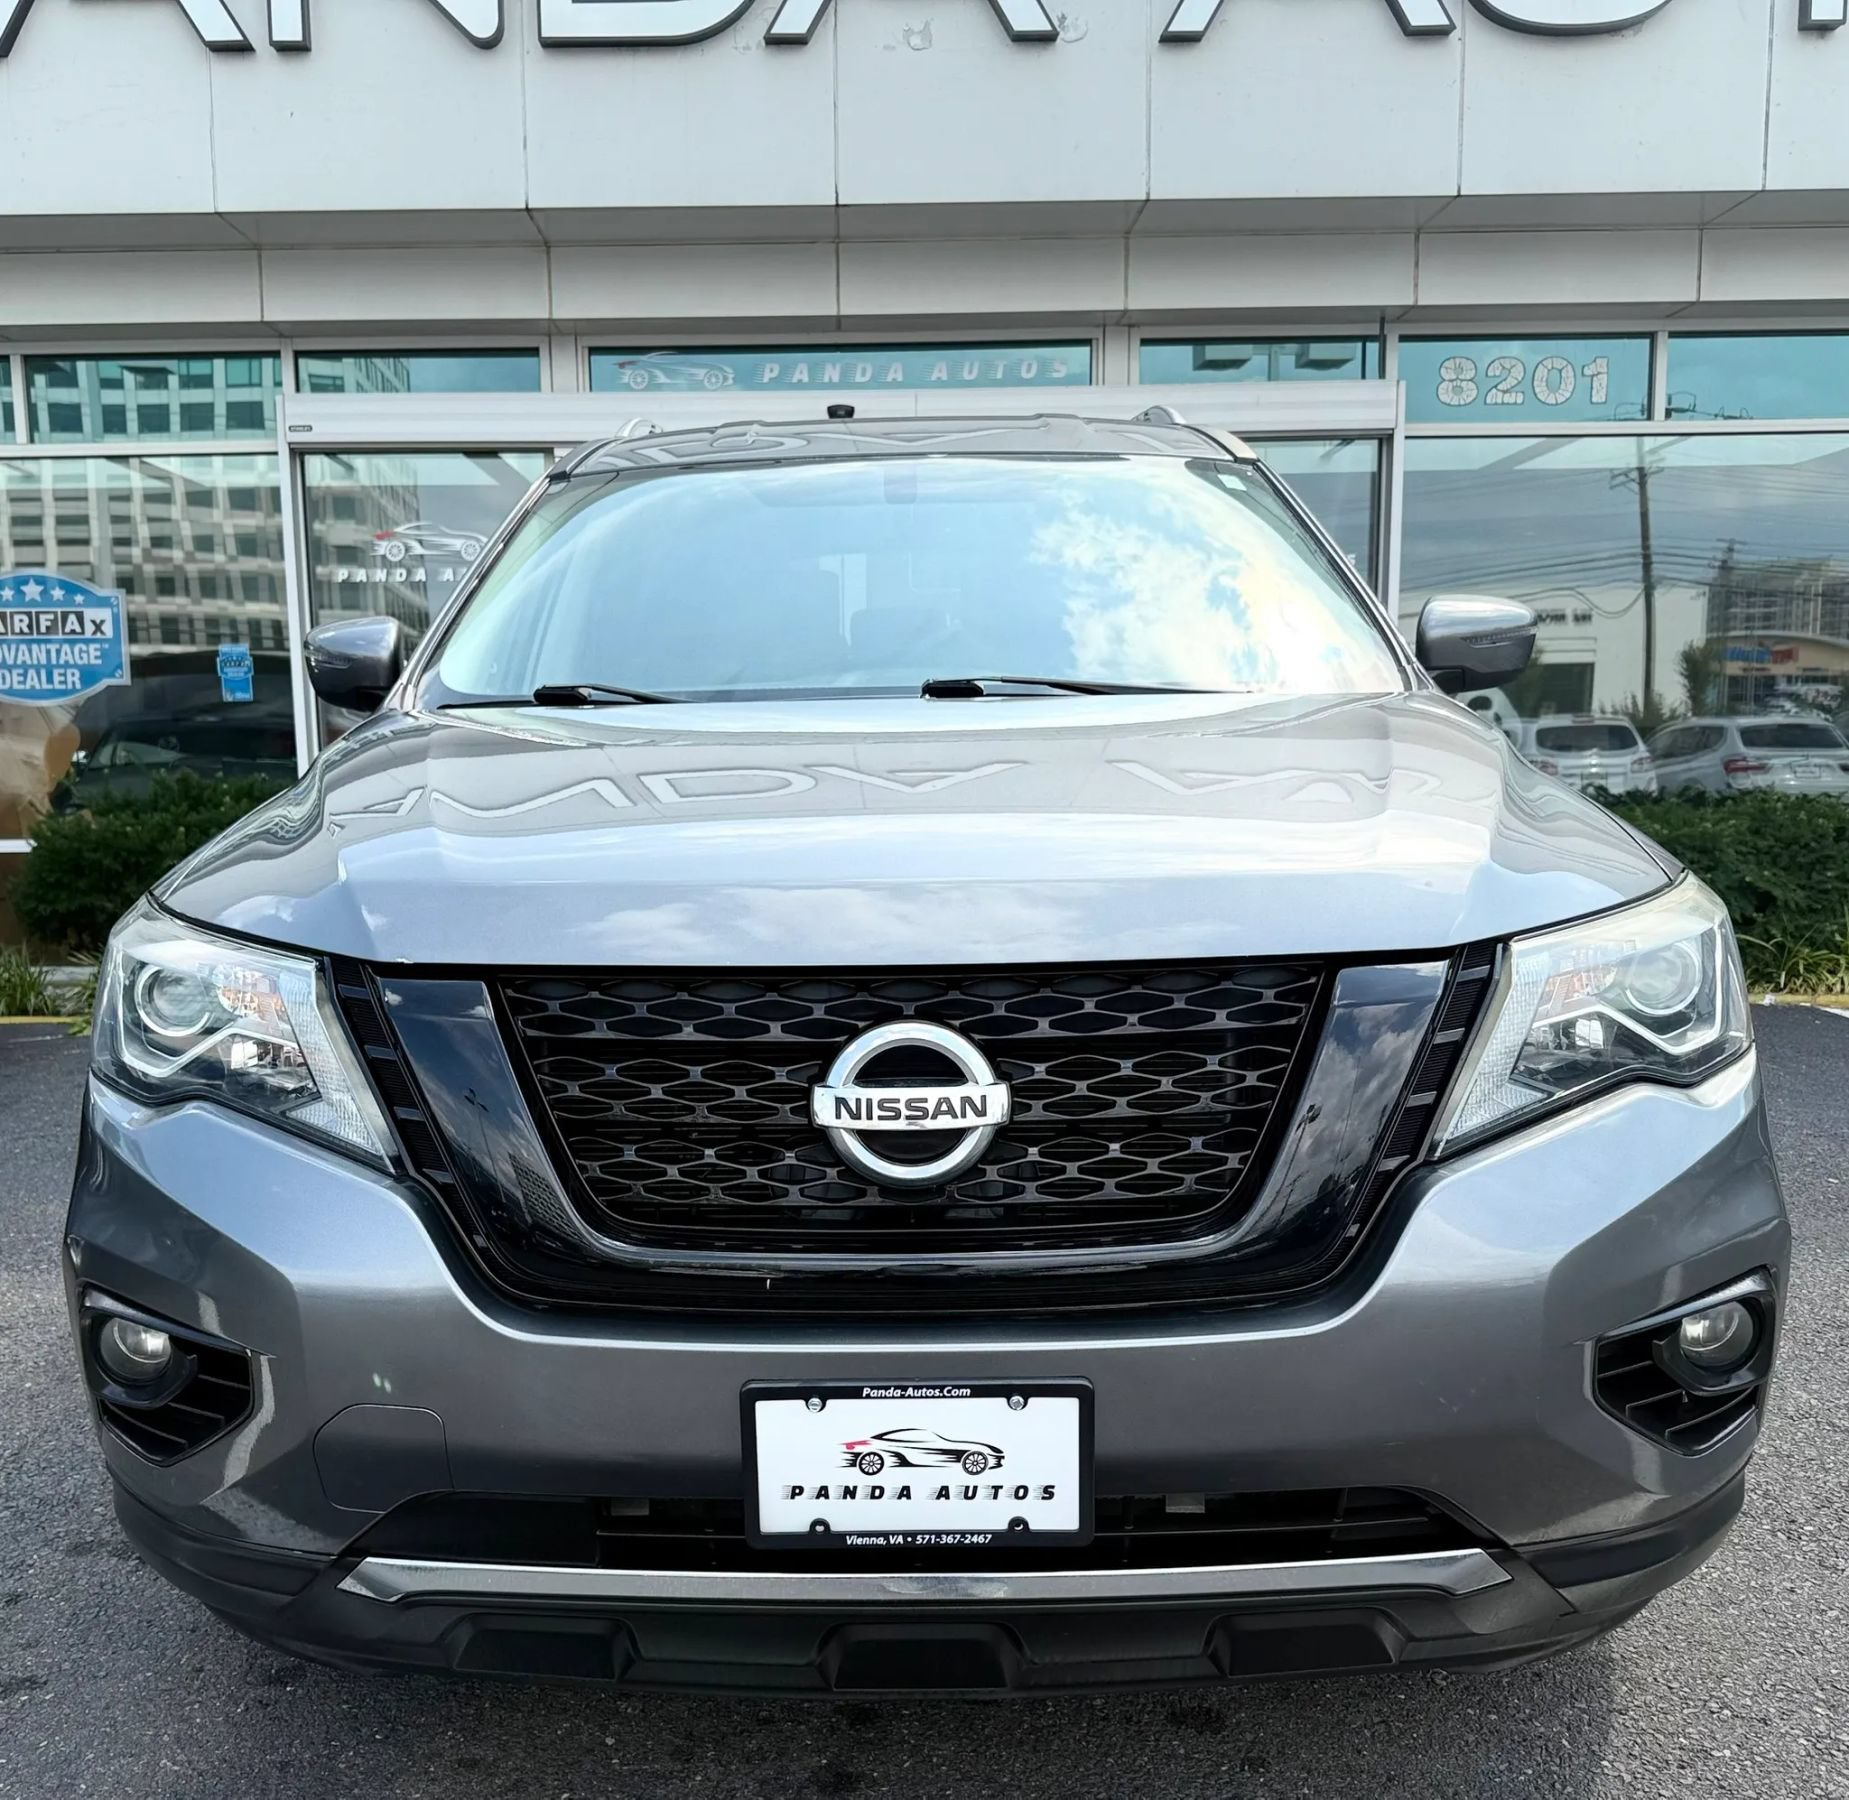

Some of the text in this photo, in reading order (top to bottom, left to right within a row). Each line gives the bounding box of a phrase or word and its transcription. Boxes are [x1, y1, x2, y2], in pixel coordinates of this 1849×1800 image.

[761, 359, 1069, 384] PANDA AUTOS
[1436, 356, 1610, 407] 8201
[336, 568, 427, 583] PANDA
[0, 643, 103, 665] VANTAGE
[0, 668, 82, 690] DEALER
[834, 1094, 988, 1121] NISSAN
[862, 1386, 971, 1398] Panda-Autos.Com
[787, 1484, 1056, 1501] PANDA AUTOS
[845, 1534, 993, 1546] Vienna, VA 571-367-2467
